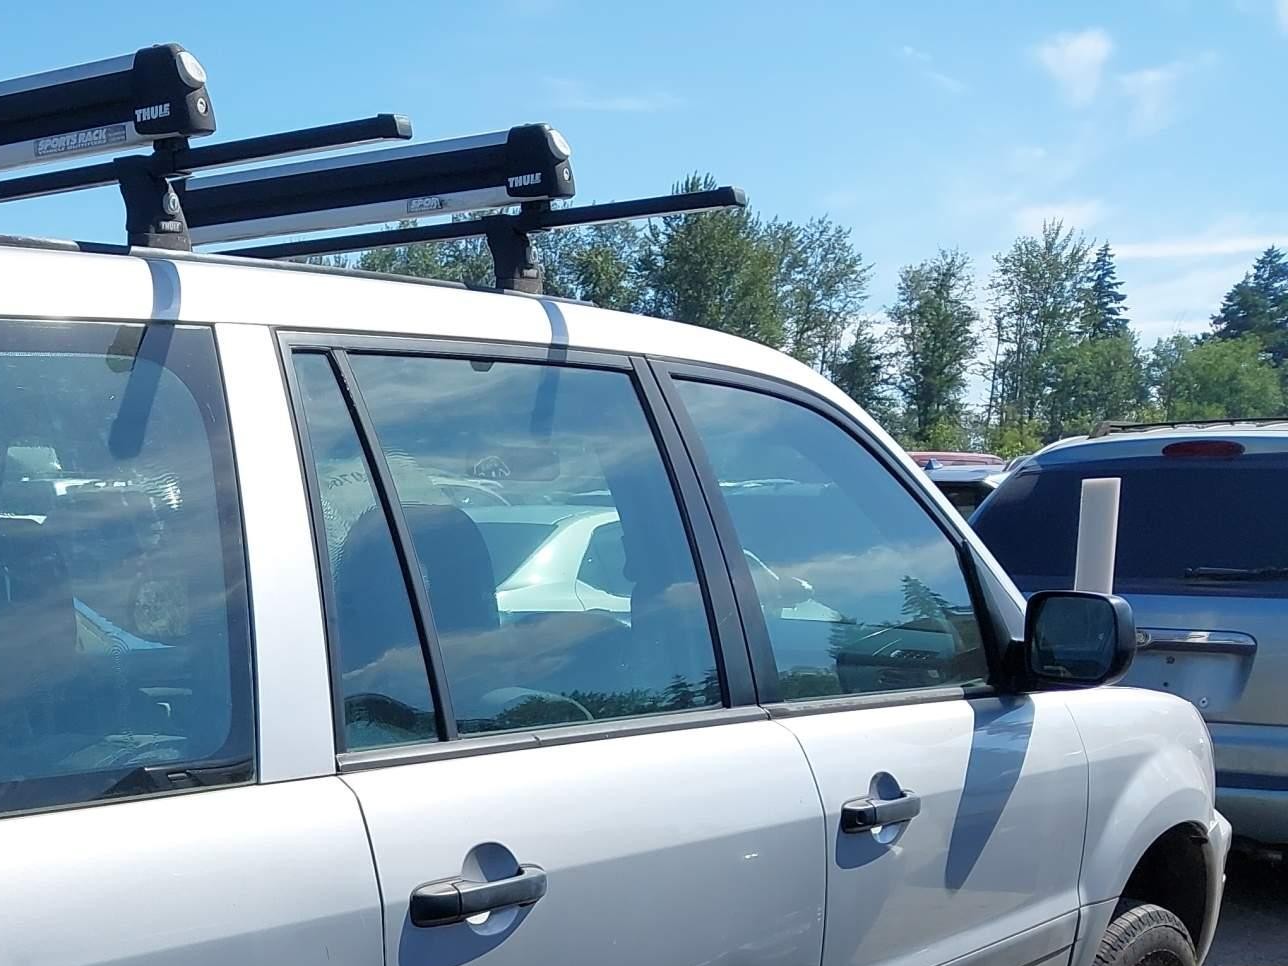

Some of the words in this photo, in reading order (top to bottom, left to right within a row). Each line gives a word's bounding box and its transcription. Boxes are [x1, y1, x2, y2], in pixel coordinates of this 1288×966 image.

[135, 103, 170, 123] THULE
[37, 133, 78, 151] SPORTS
[78, 128, 107, 145] RACK
[507, 172, 542, 188] THULE
